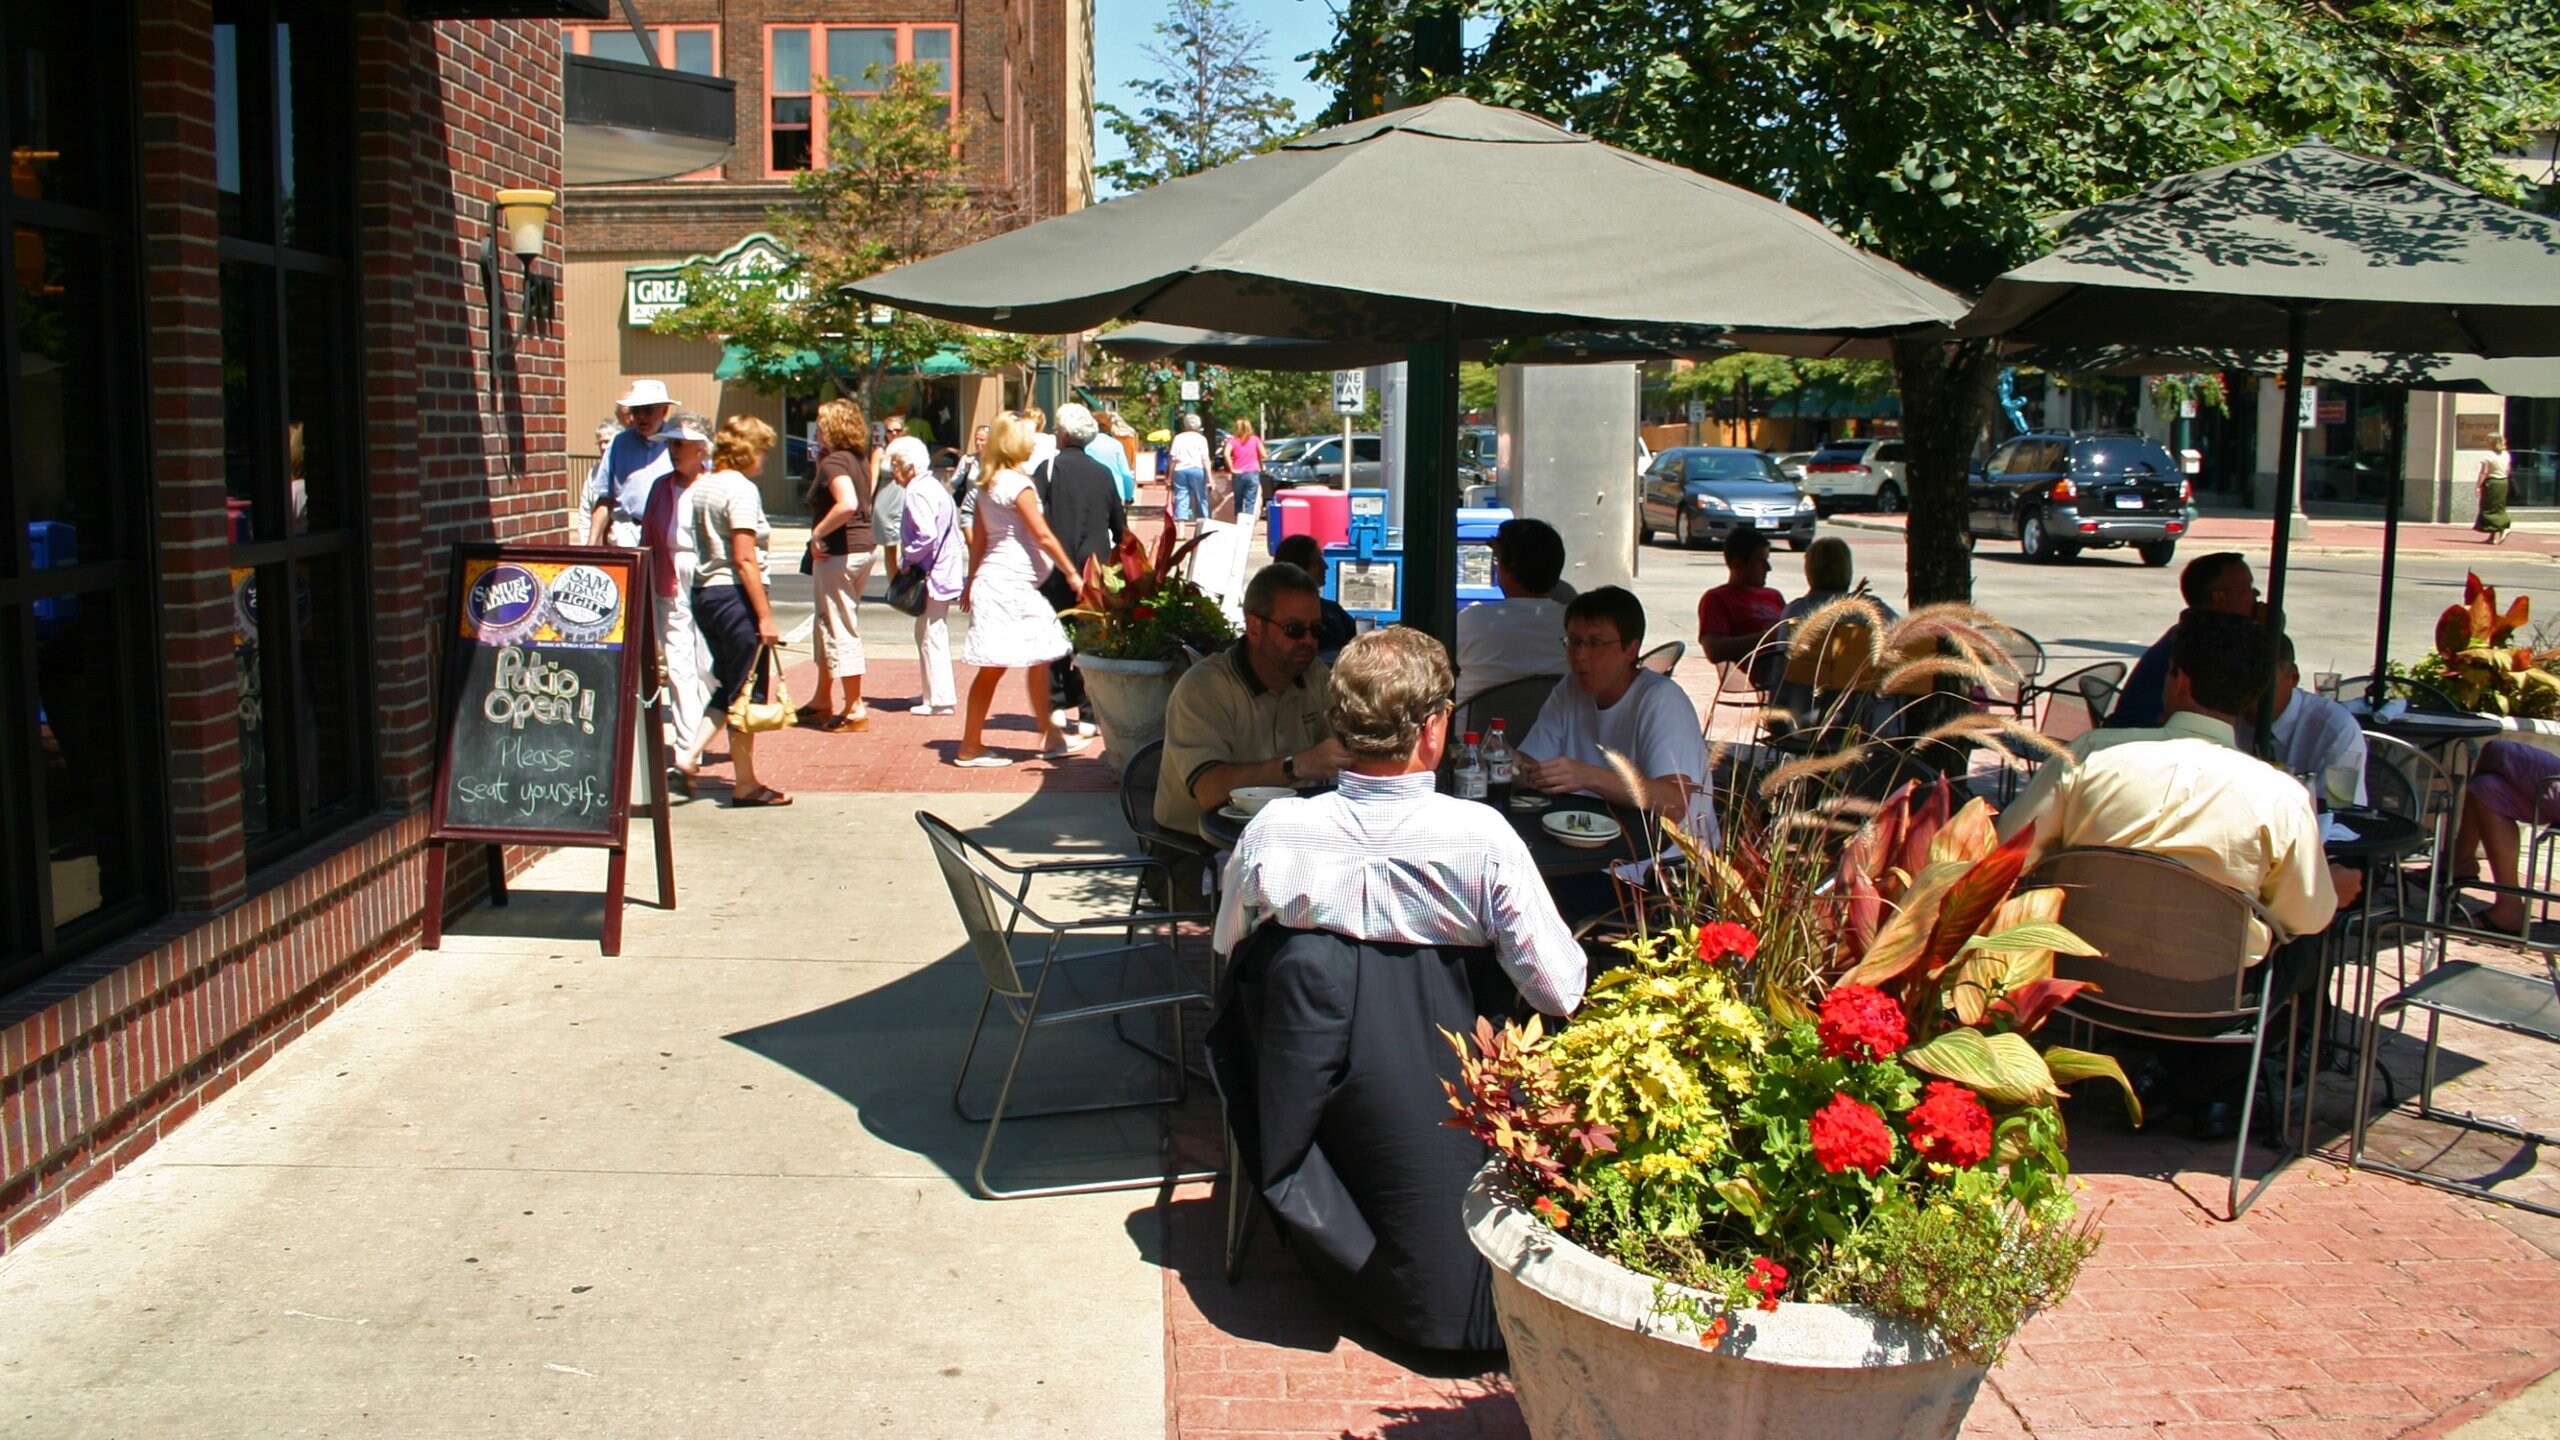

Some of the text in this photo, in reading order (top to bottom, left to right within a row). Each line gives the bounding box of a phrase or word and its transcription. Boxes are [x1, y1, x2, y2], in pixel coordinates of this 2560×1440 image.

[637, 280, 690, 303] GREA
[1336, 372, 1361, 383] ONE
[1336, 385, 1361, 395] WAY
[2300, 390, 2312, 400] NE
[2300, 401, 2312, 411] AY
[474, 576, 532, 602] SAMUEL
[570, 567, 611, 592] SAM
[482, 588, 529, 613] ADAMS
[559, 592, 606, 614] LIGHT
[562, 582, 608, 603] ADAMS
[495, 646, 579, 698] Patio
[497, 736, 574, 772] Please
[458, 773, 509, 803] Seat
